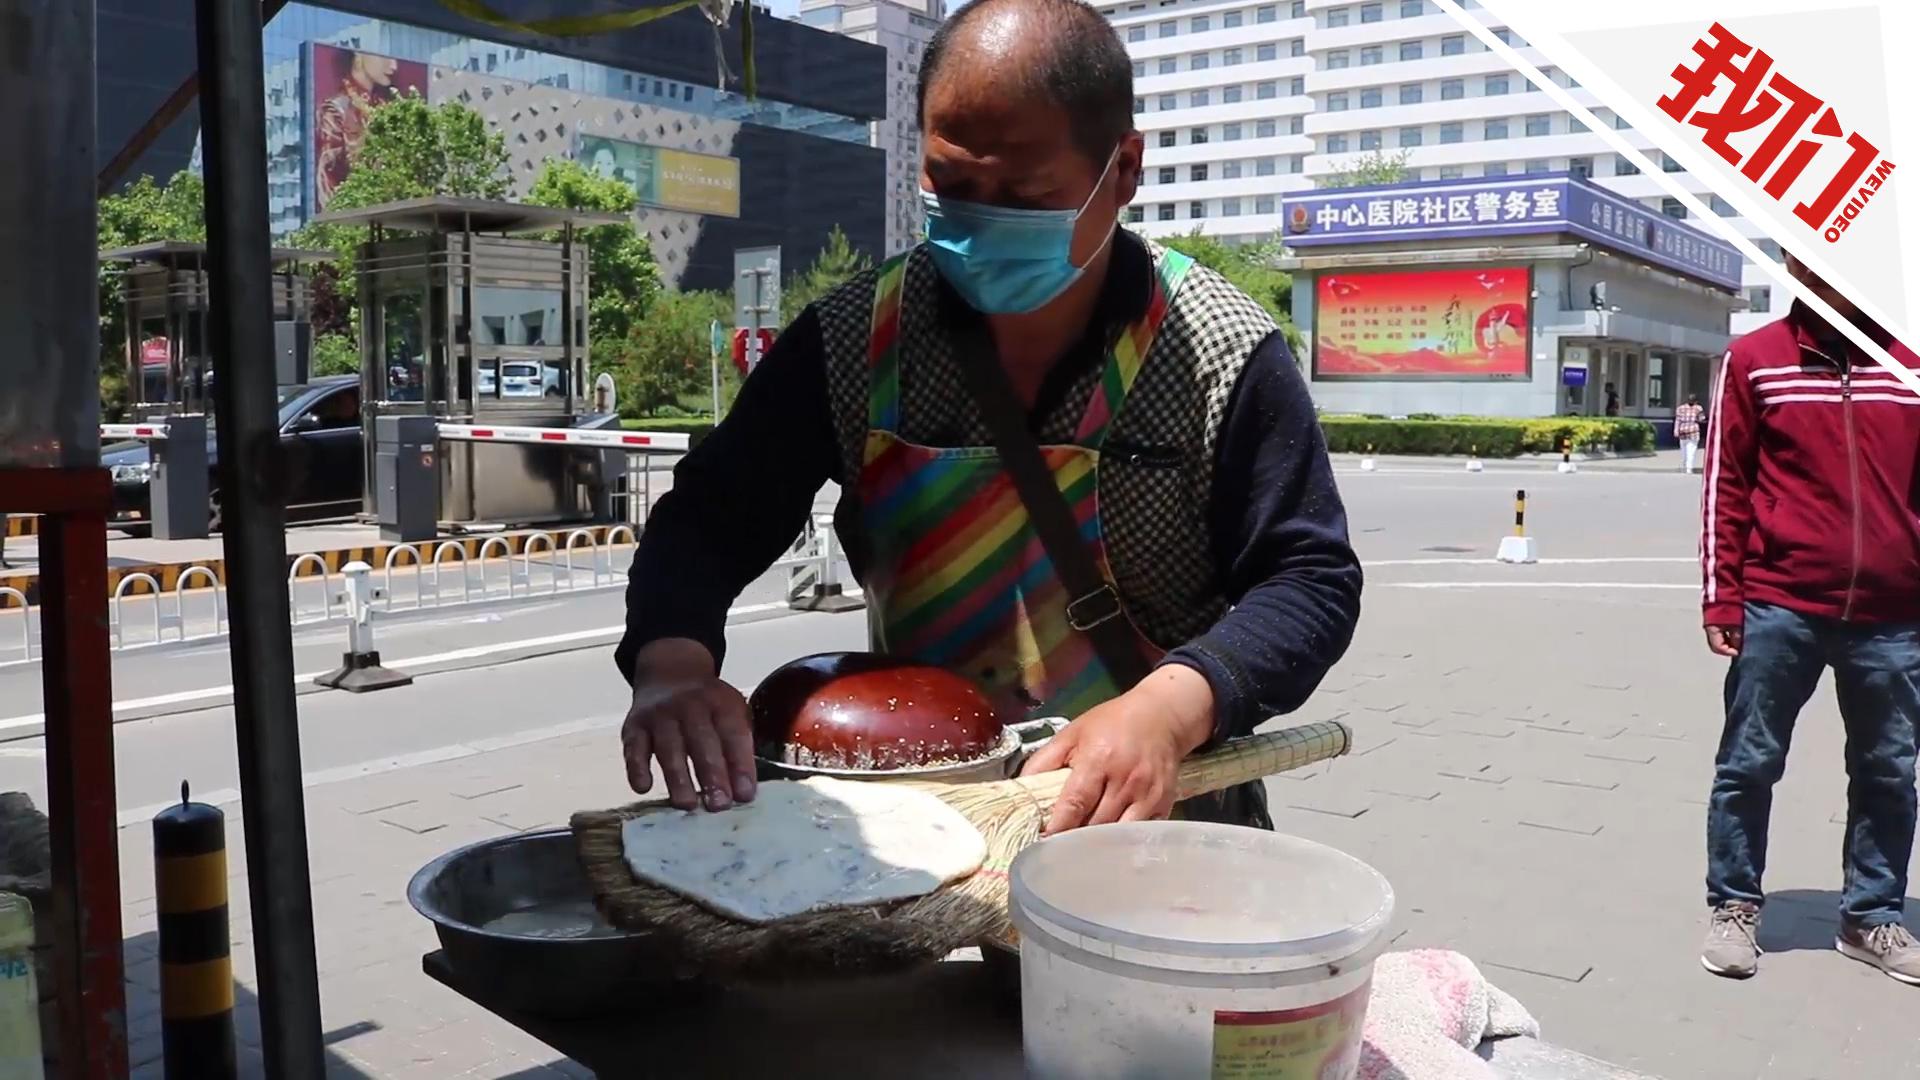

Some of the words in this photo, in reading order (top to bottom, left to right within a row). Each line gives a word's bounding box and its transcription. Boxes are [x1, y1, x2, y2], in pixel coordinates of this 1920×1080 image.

[1316, 188, 1560, 231] 中心医院社区警务室
